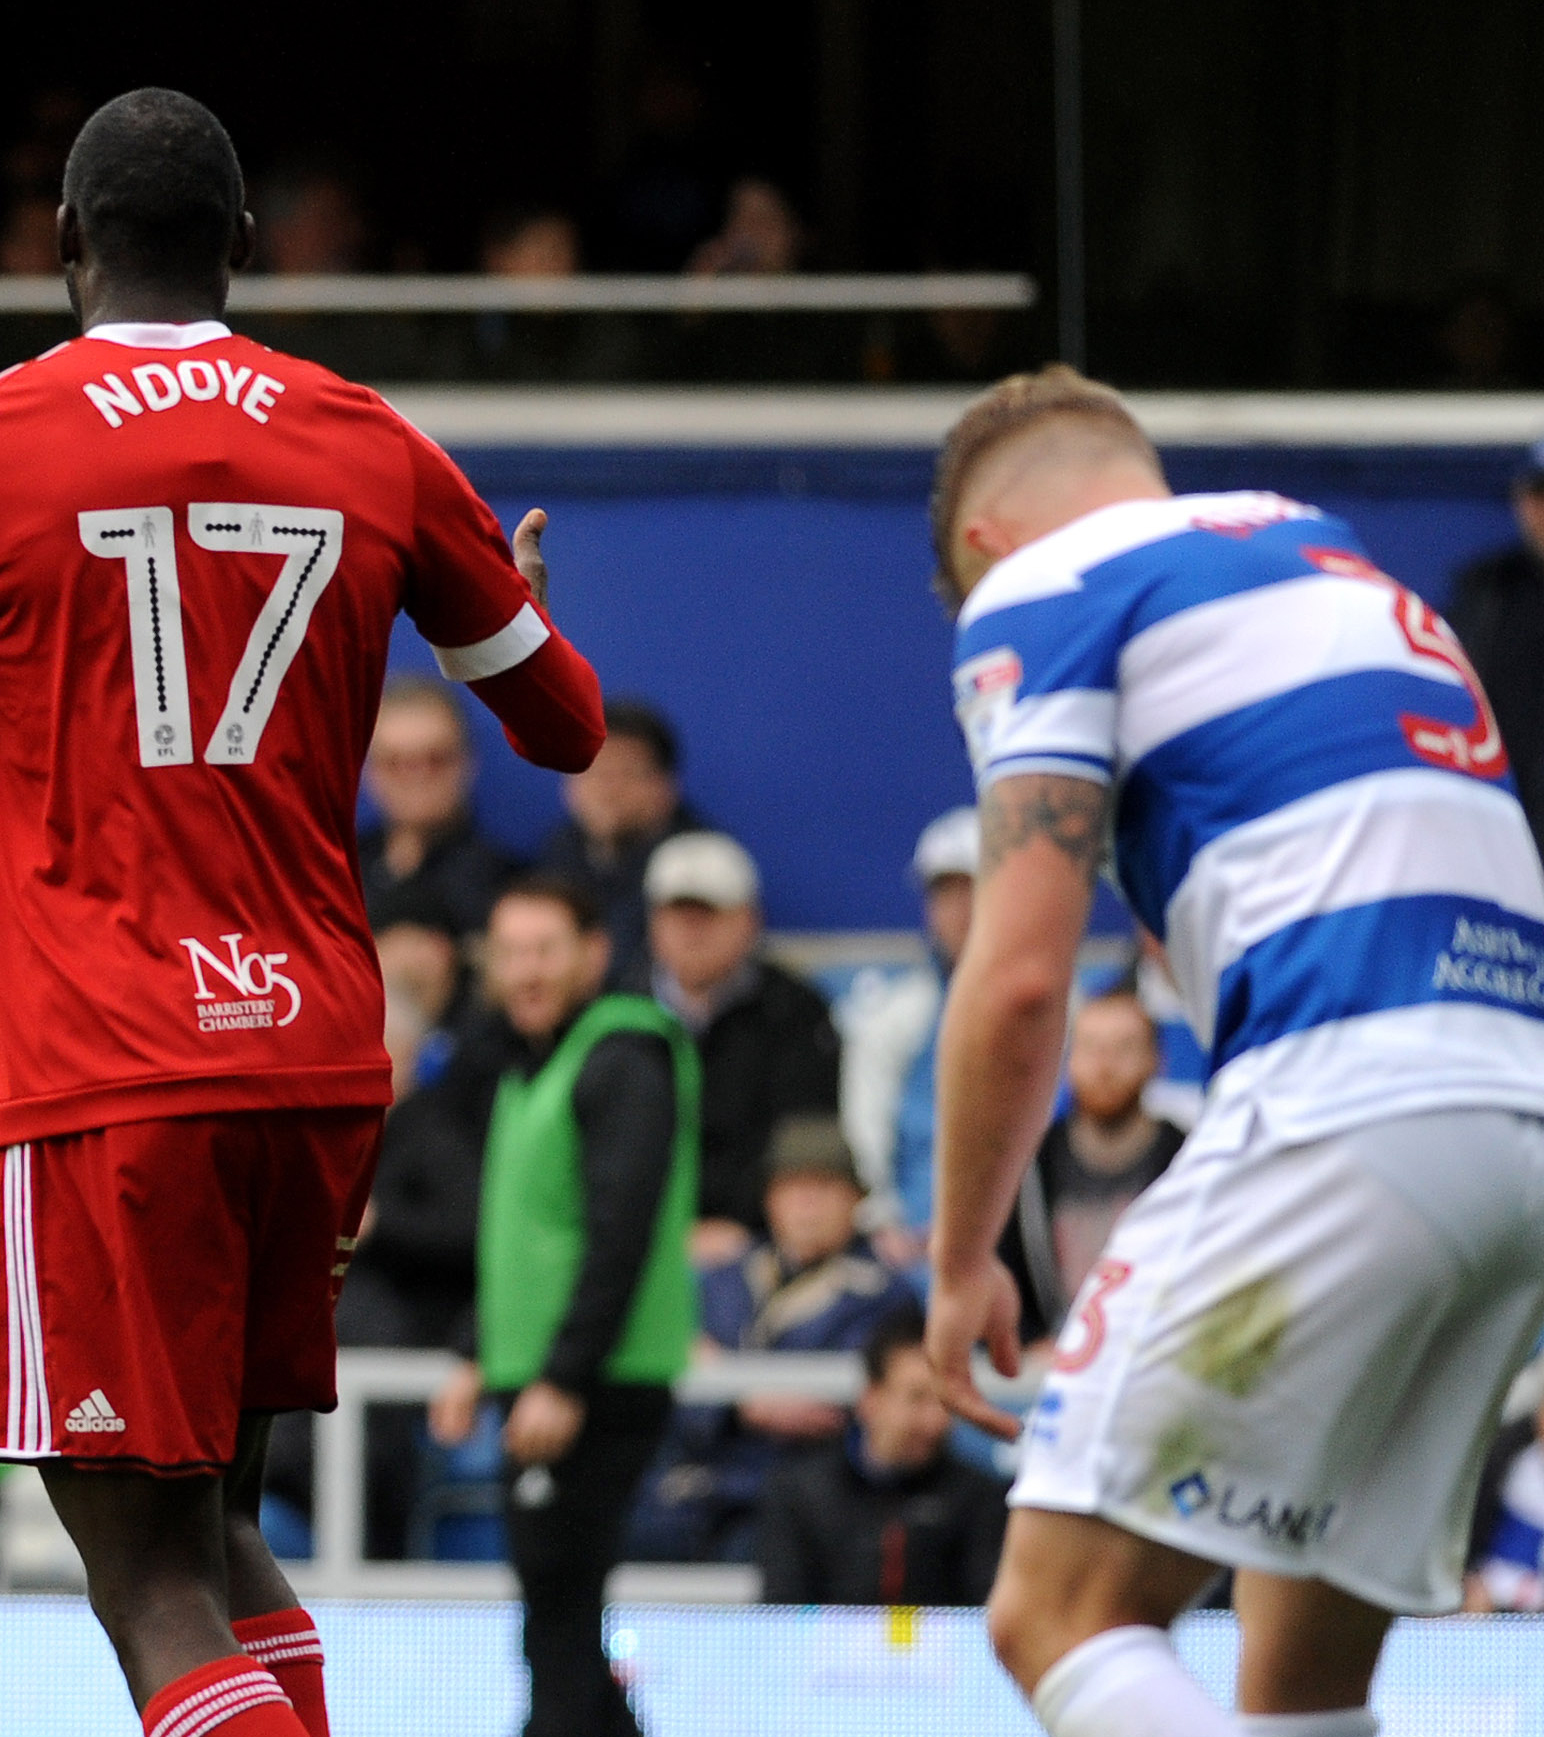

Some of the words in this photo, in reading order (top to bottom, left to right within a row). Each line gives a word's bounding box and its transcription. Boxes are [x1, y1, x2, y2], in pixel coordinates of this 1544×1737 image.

[82, 358, 286, 429] NDOYE
[77, 502, 344, 768] 17
[178, 933, 302, 1027] No5
[198, 1013, 274, 1032] CHAMBERS
[64, 1417, 127, 1433] adidas
